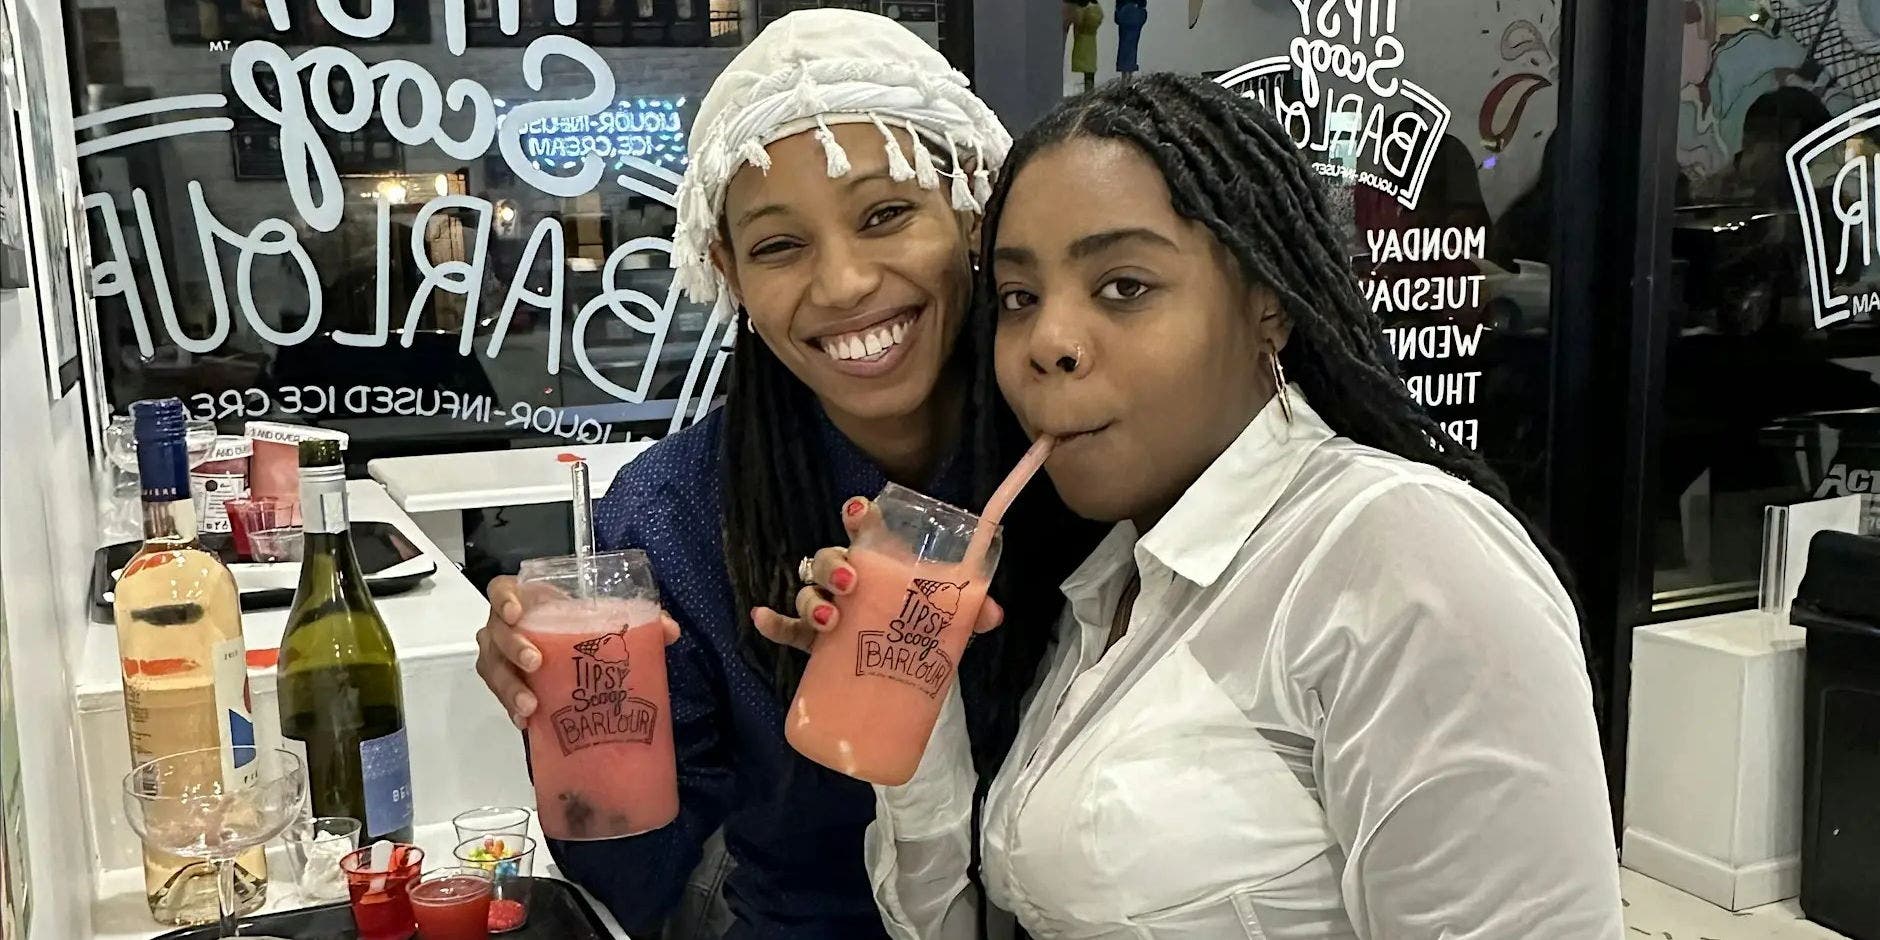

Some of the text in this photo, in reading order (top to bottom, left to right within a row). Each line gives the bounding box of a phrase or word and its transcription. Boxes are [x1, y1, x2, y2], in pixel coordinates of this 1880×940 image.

[900, 589, 951, 637] TIPSY
[887, 620, 938, 661] Scoop
[572, 656, 630, 692] TIPSY
[865, 641, 945, 687] BARLOUR
[572, 689, 628, 716] Scoop
[560, 709, 649, 744] BARLOUR
